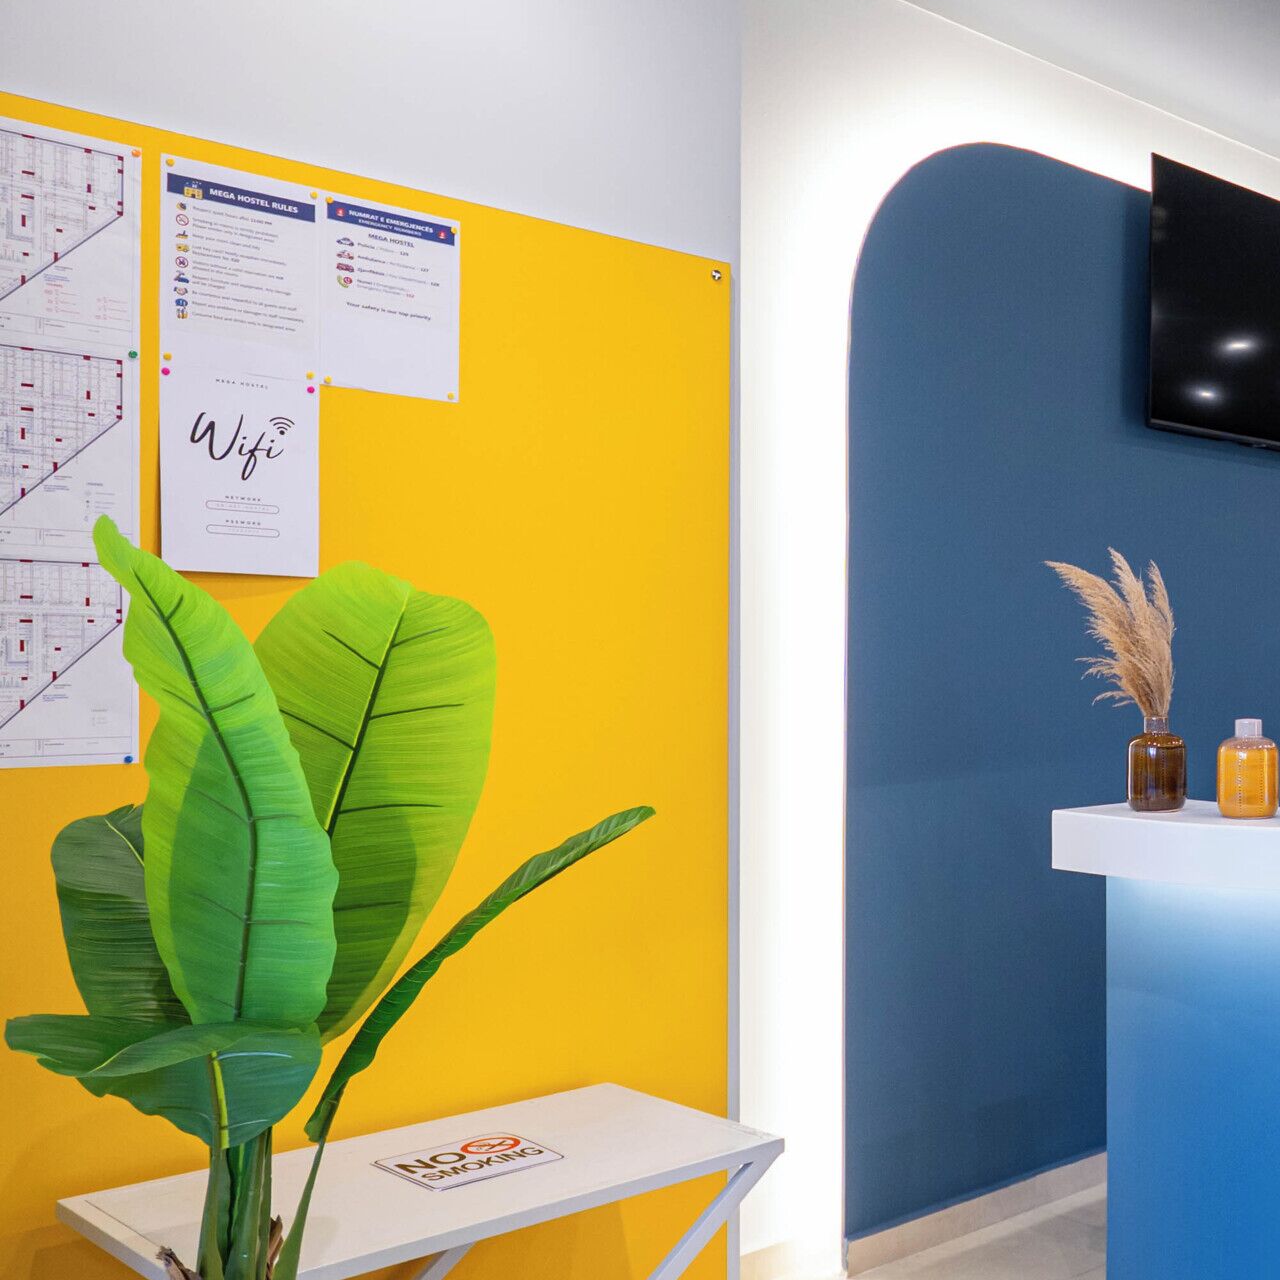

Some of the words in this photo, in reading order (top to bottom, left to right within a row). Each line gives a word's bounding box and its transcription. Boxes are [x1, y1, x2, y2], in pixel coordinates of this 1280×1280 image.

[209, 188, 236, 200] MEGA
[237, 194, 270, 208] HOSTEL
[271, 201, 299, 214] RULES
[348, 209, 379, 221] NUMRAT
[358, 218, 393, 230] EMERGENCY
[368, 233, 390, 242] MEGA
[389, 238, 415, 249] HOSTEL
[189, 411, 285, 481] Wifi
[394, 1151, 467, 1175] NO
[421, 1146, 545, 1182] SMOKING
